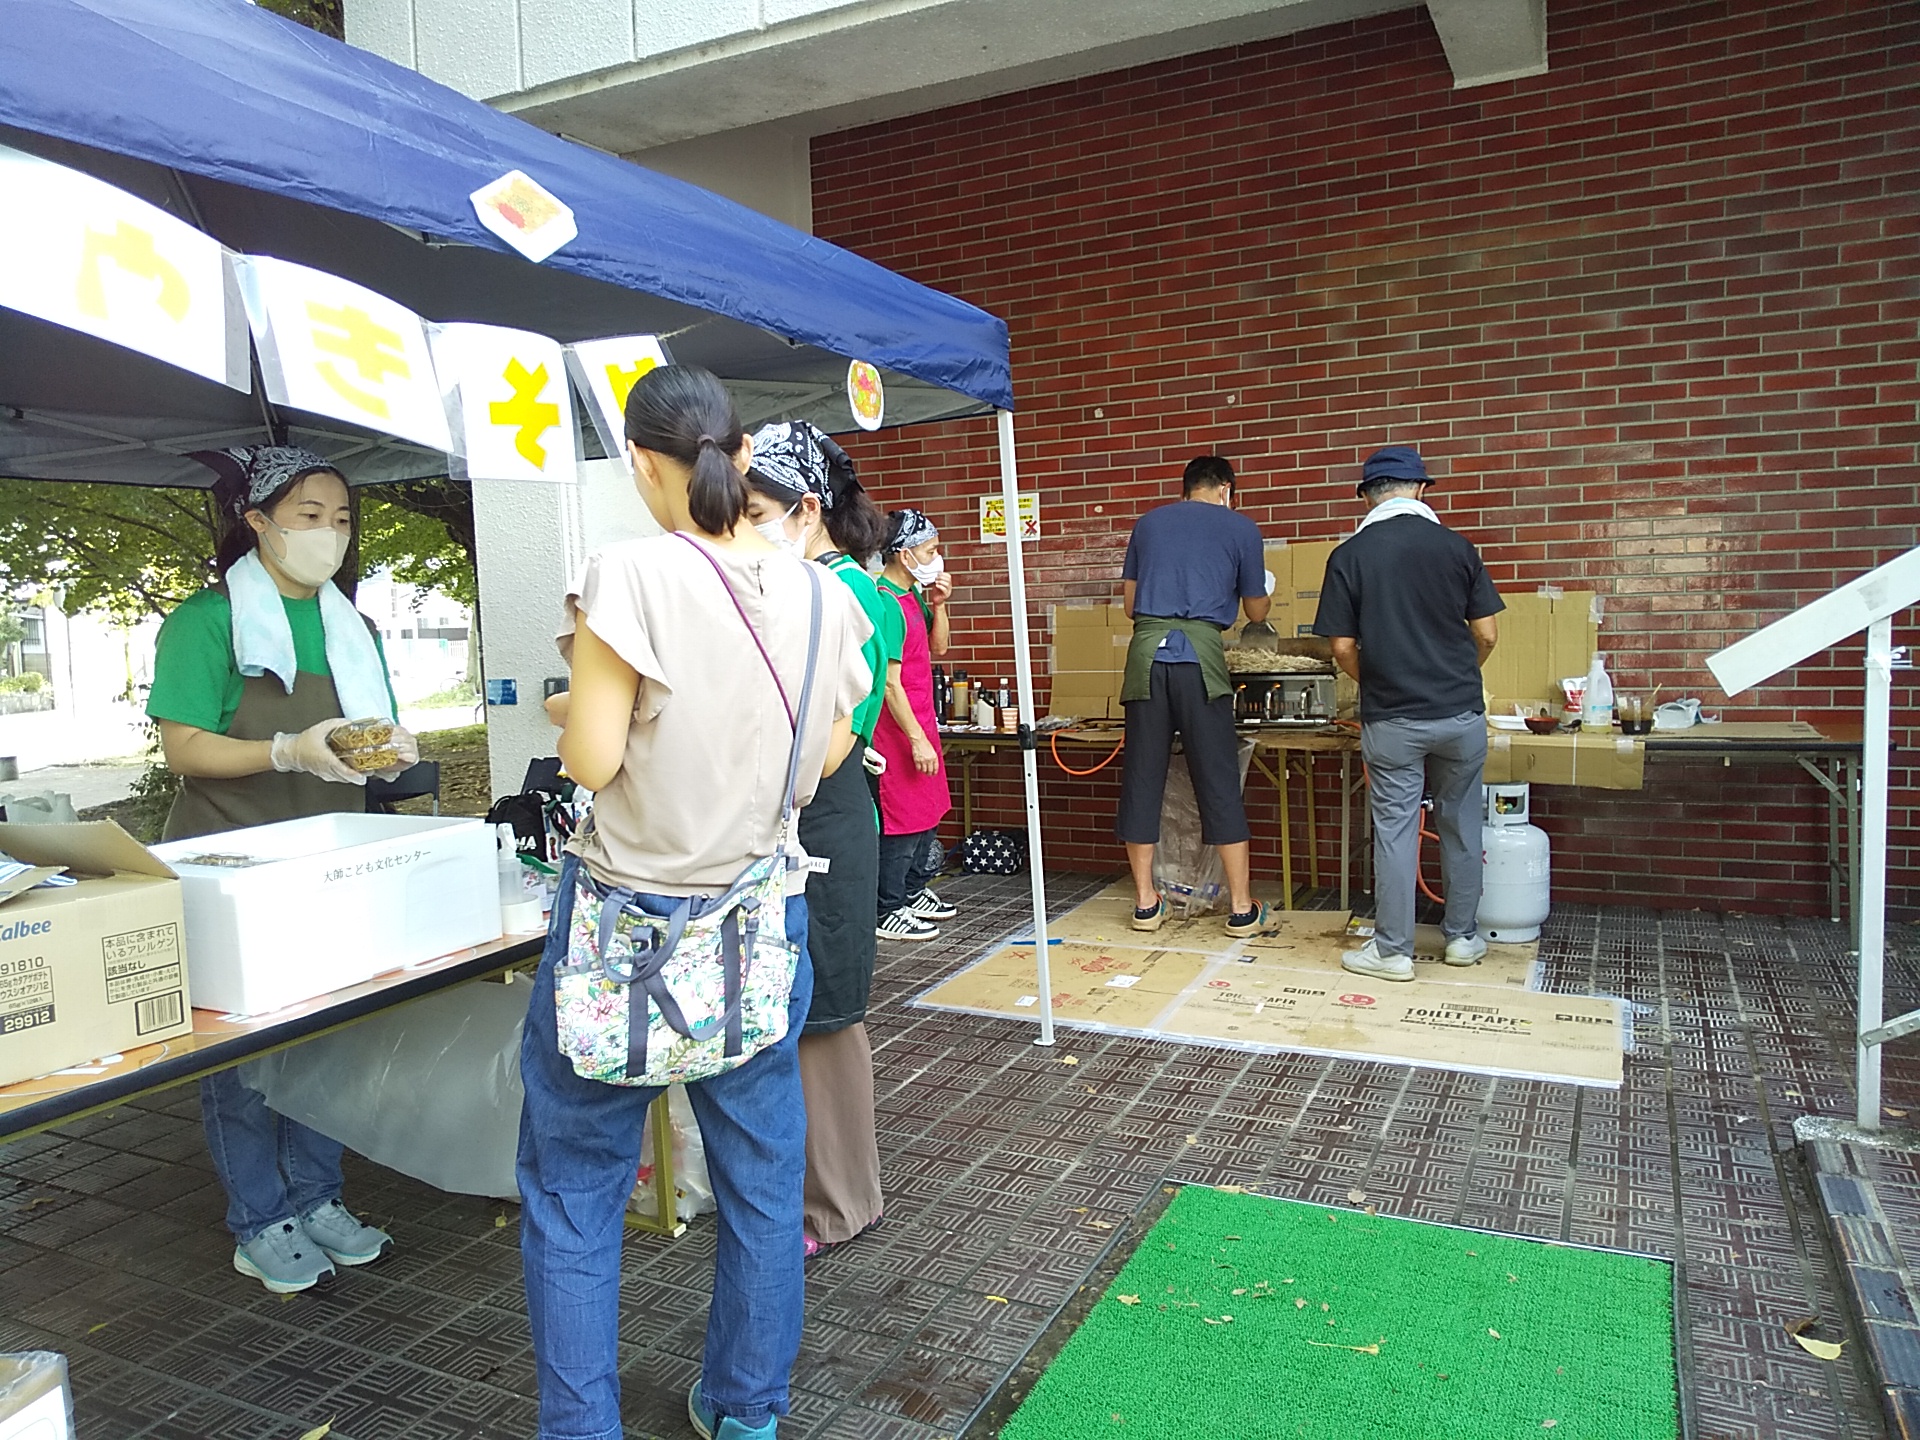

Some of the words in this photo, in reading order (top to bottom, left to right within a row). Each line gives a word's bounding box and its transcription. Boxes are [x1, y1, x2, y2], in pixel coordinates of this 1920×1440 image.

[323, 850, 432, 883] 大師こども文化センター
[0, 919, 52, 942] albee
[104, 925, 175, 948] 本品に含まれて
[105, 937, 175, 960] いるアレルゲン
[0, 956, 44, 975] 91810
[107, 960, 147, 977] 該当なし
[0, 981, 49, 1000] ウスシオアジ12
[4, 1010, 50, 1032] 29912
[1406, 1007, 1464, 1020] TOILET
